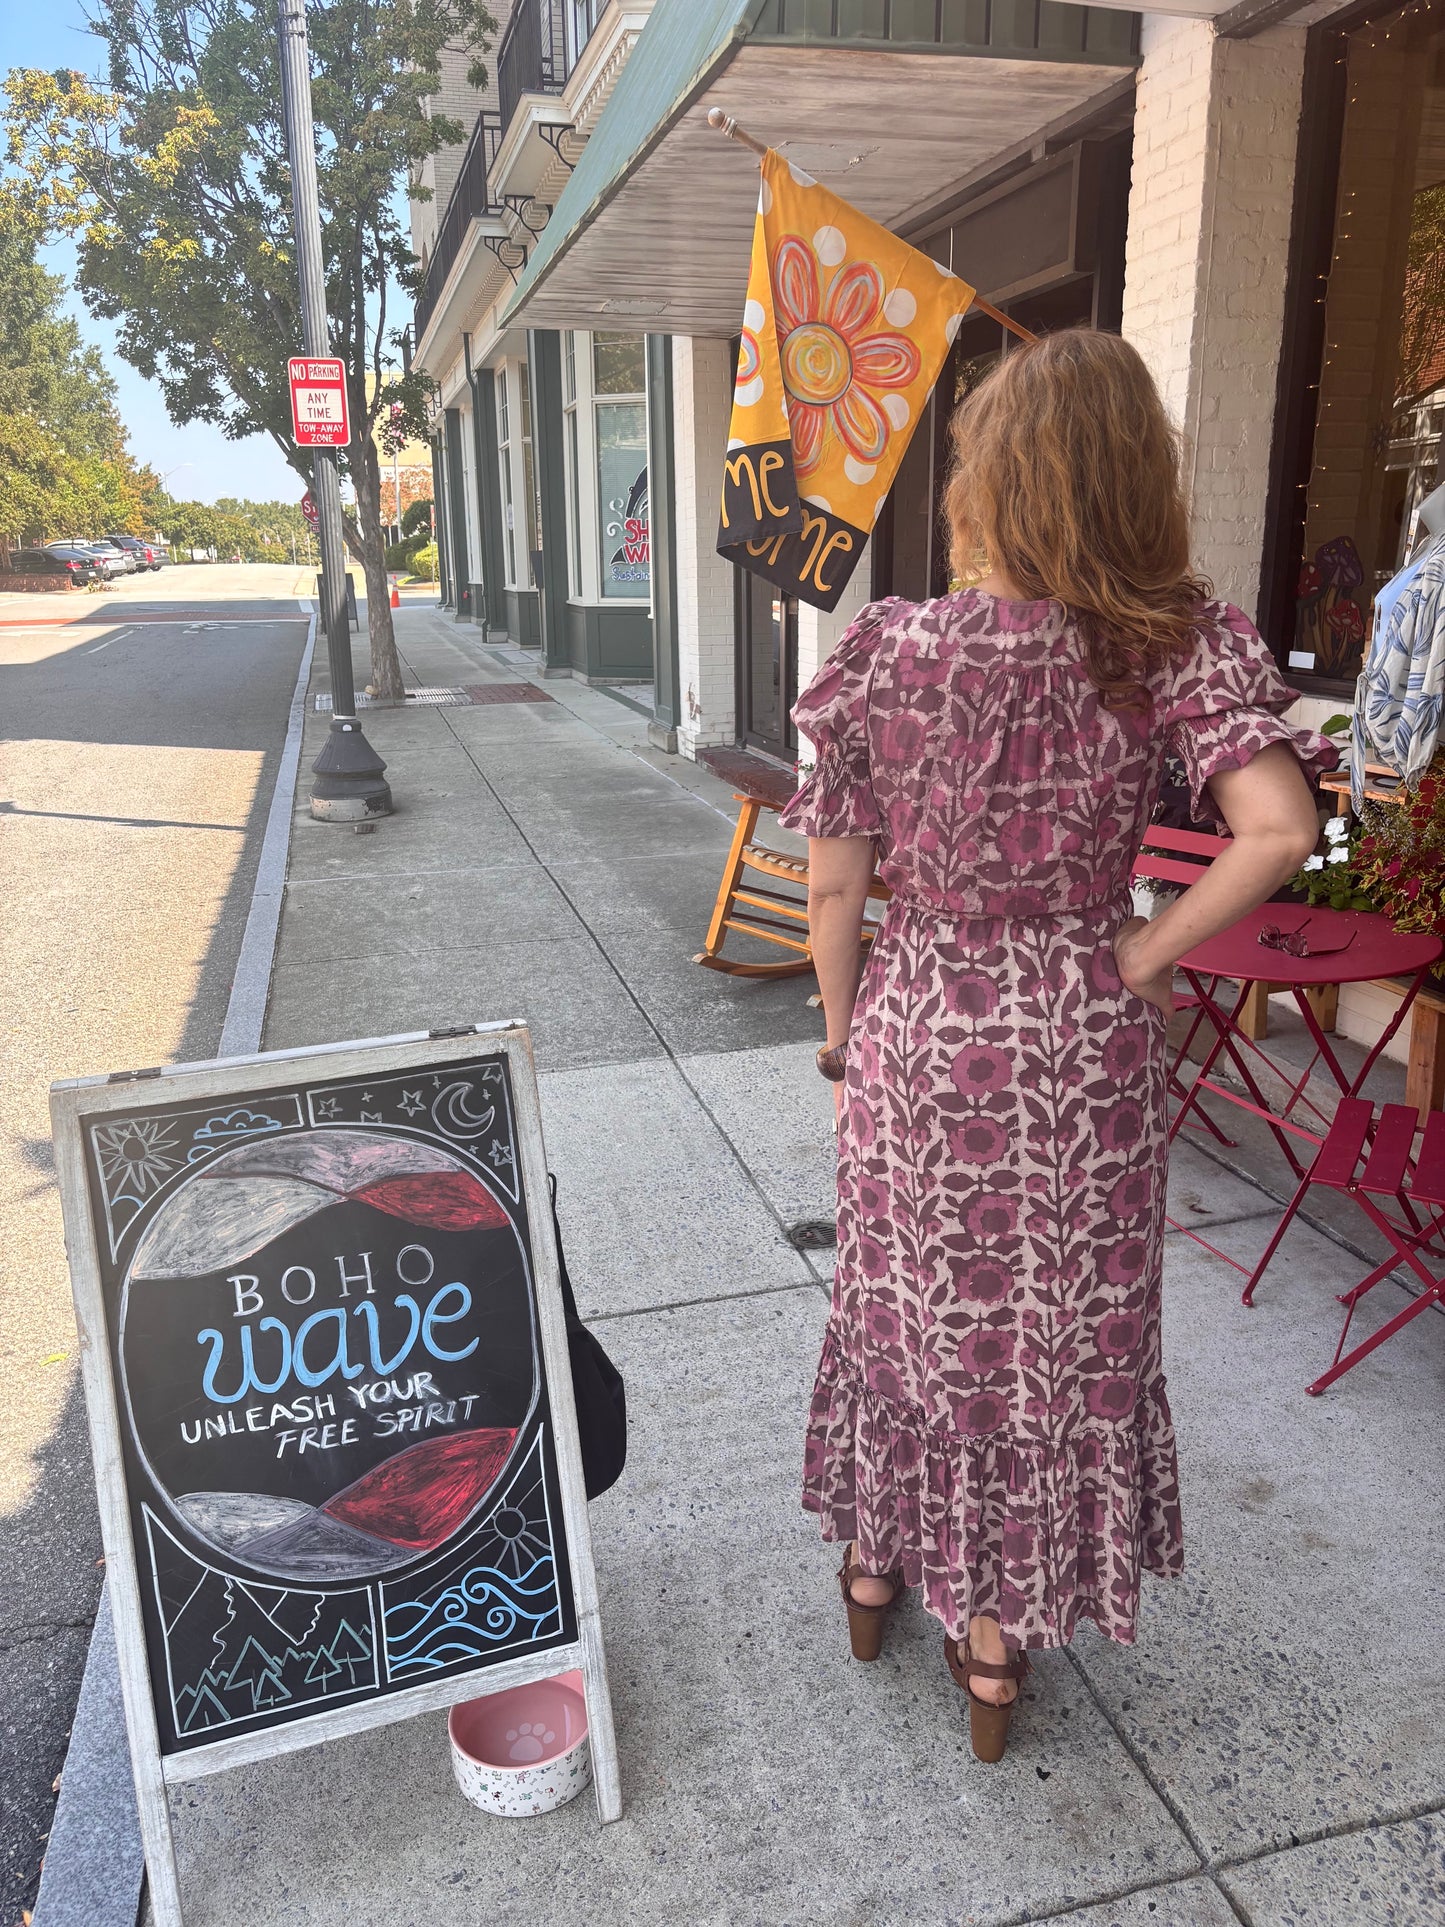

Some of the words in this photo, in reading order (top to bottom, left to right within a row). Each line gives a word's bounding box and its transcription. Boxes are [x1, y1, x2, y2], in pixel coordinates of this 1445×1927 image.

[291, 363, 306, 380] NO
[309, 366, 339, 378] PARKING
[307, 393, 328, 404] ANY
[307, 407, 332, 419] TIME
[298, 423, 344, 433] TOW-AWAY
[311, 434, 334, 443] ZONE
[226, 1244, 435, 1317] BOHO
[197, 1281, 480, 1404] wave
[180, 1393, 337, 1445] UNLEASH
[347, 1371, 441, 1410] YOUR
[274, 1418, 360, 1459] FREE
[373, 1394, 480, 1438] SPIRIT
